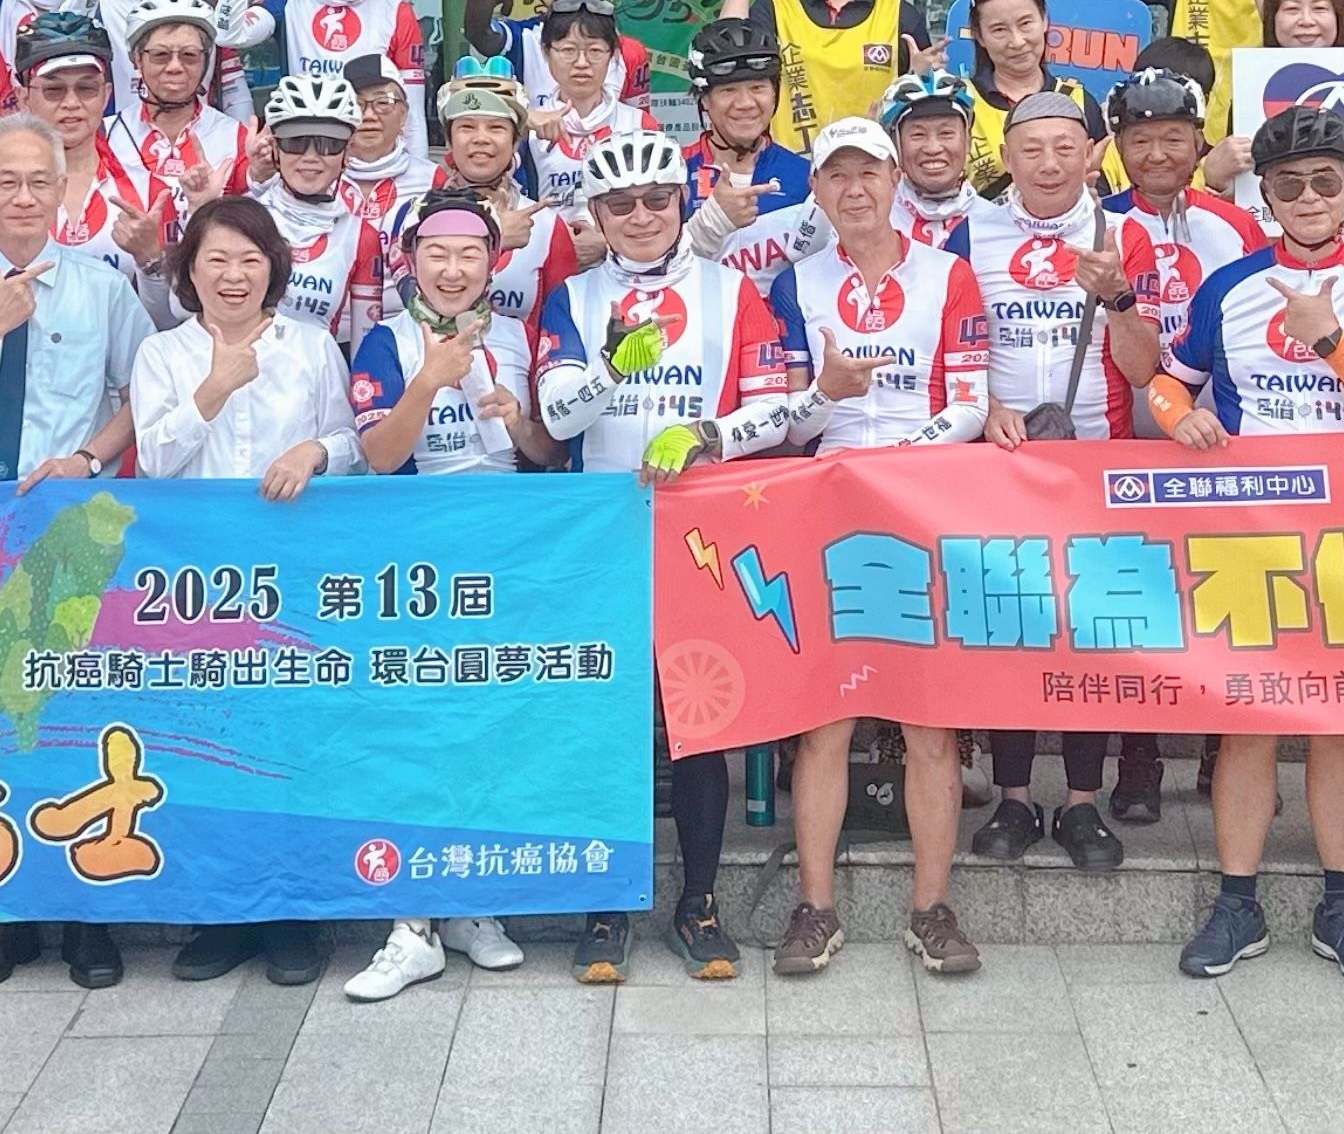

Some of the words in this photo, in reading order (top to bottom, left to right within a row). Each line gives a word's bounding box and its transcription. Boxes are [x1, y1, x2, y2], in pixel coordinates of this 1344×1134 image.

[1043, 25, 1140, 74] RUN
[782, 41, 818, 155] 企業志工
[1162, 474, 1316, 500] 全聯福利中心
[135, 565, 282, 623] 2025
[318, 563, 494, 622] 第13屆
[24, 648, 352, 691] 抗癌騎士騎出生命
[370, 642, 614, 686] 環台圓夢活動
[408, 840, 615, 880] 台灣抗癌協會
